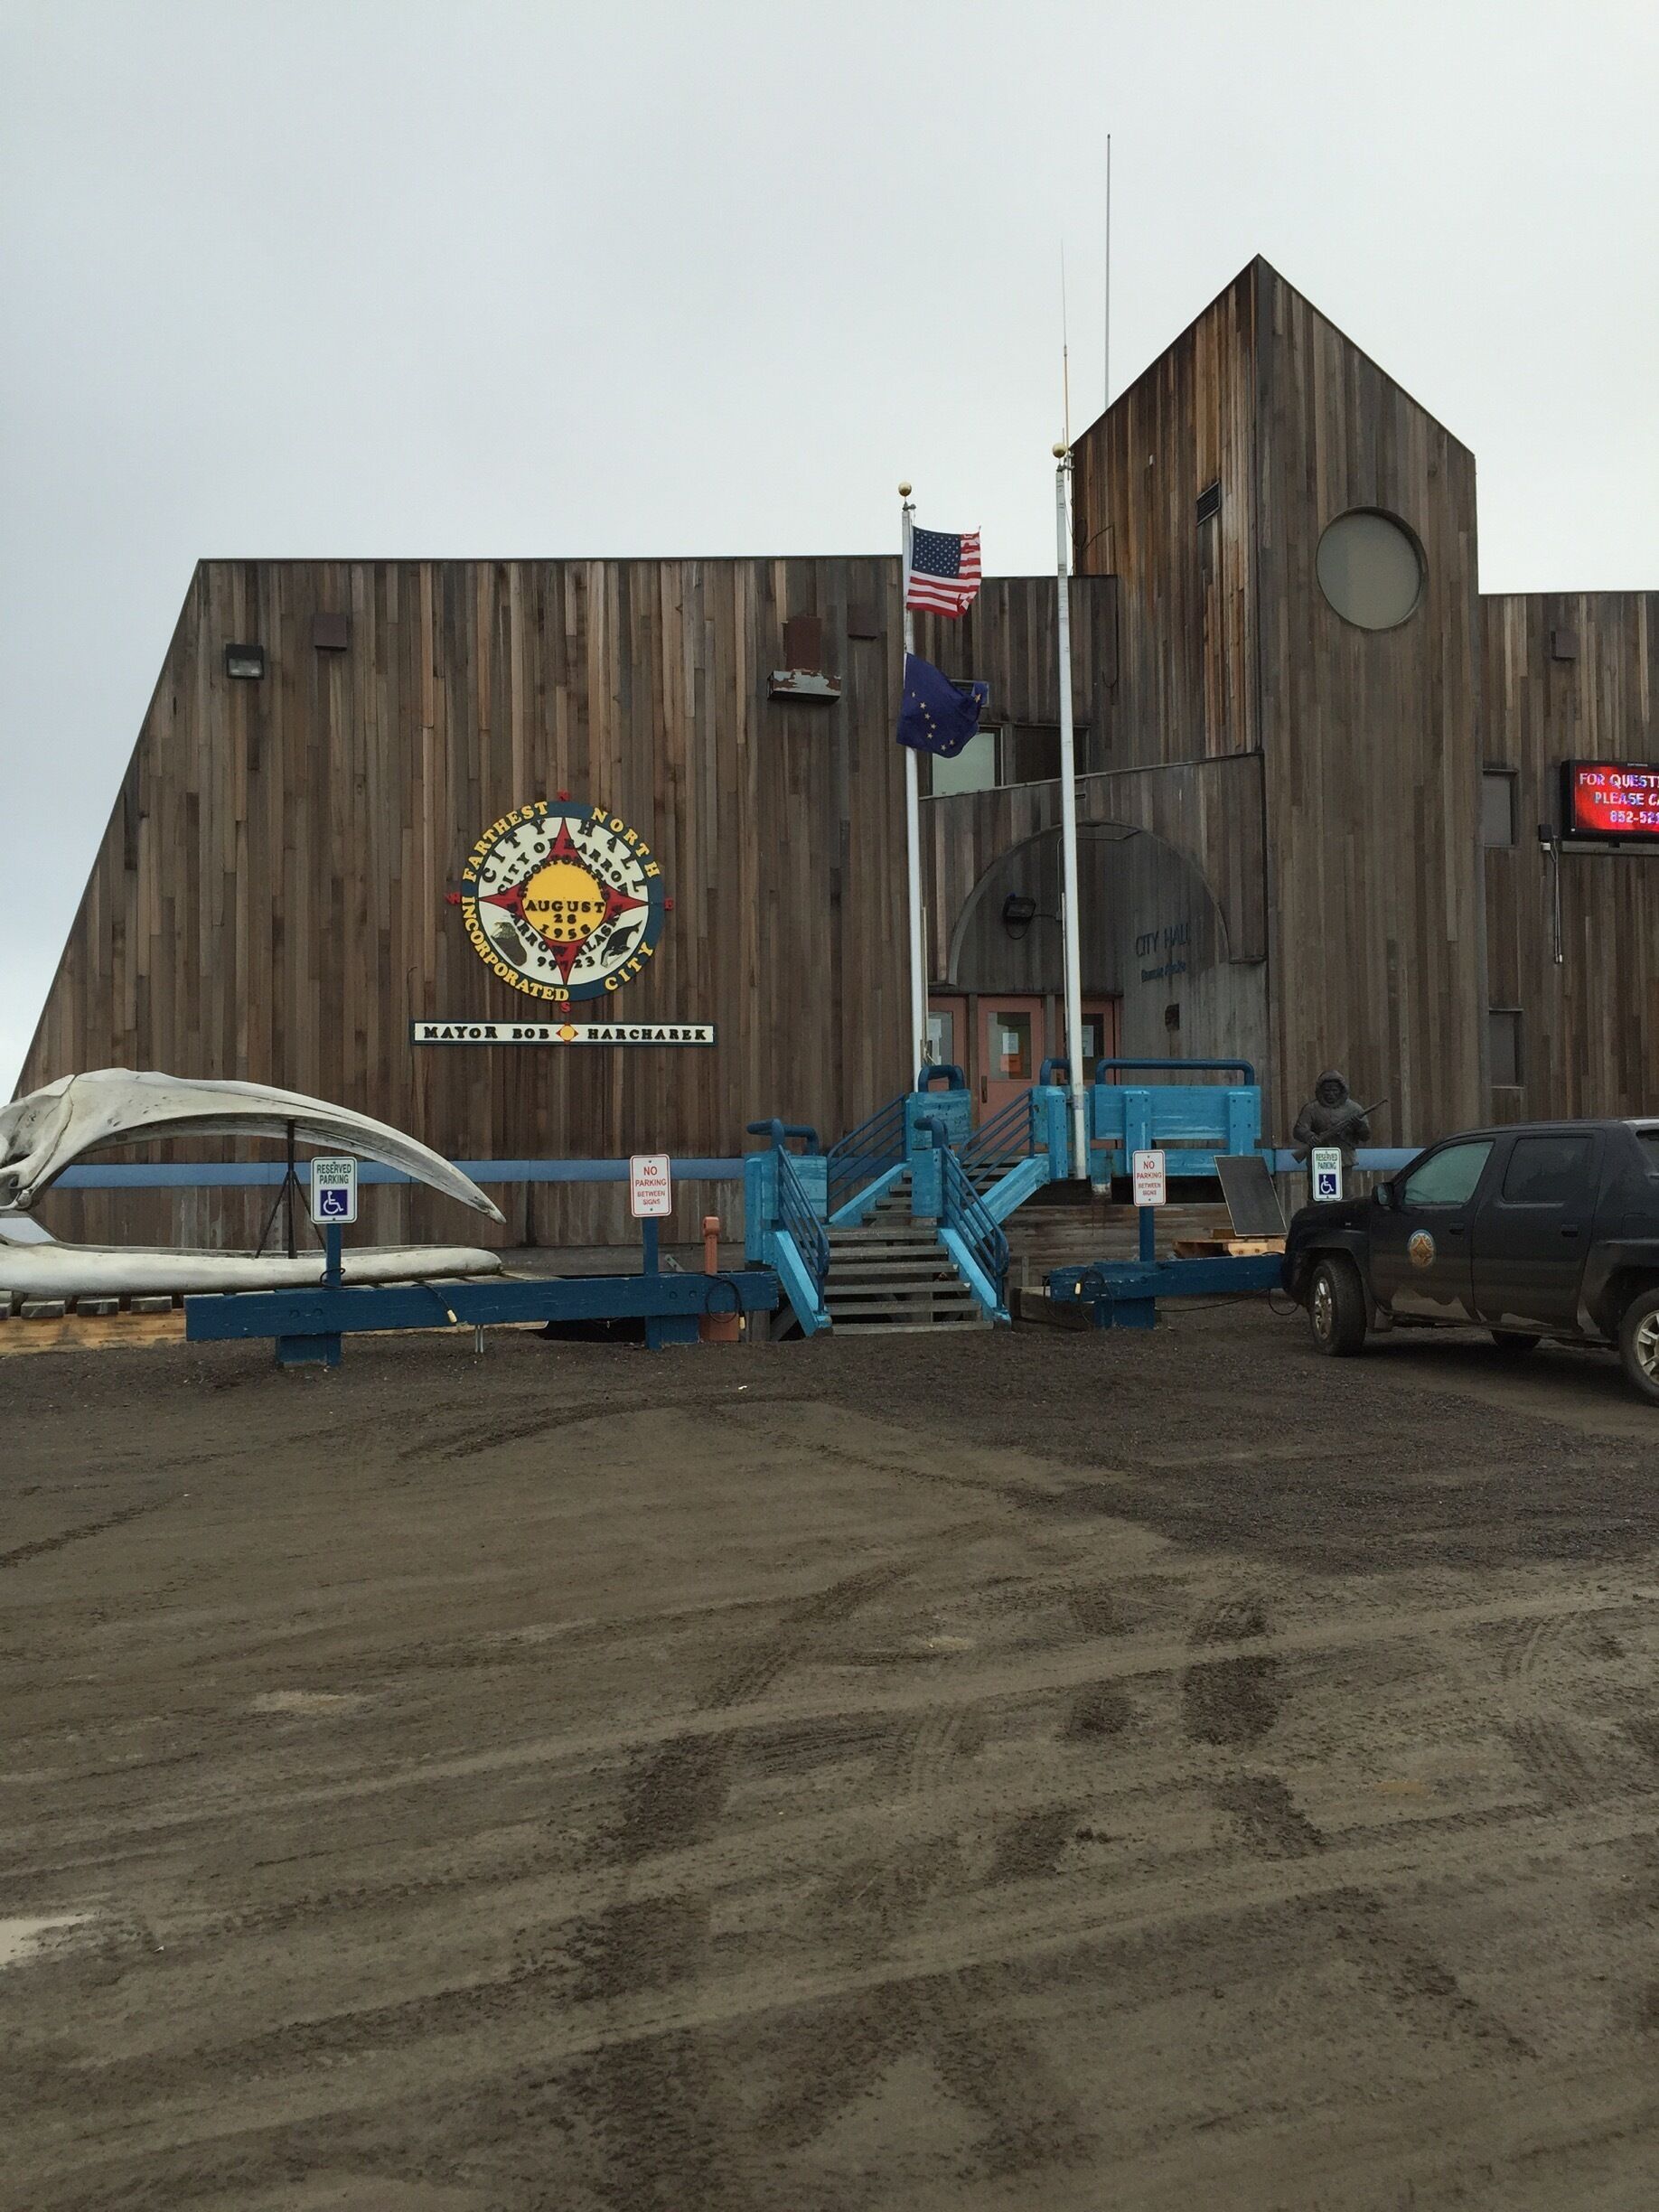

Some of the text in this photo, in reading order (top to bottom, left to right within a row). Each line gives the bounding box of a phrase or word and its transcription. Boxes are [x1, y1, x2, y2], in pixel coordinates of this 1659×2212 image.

[1579, 773, 1606, 785] FOR
[1594, 792, 1645, 805] PLEASE
[462, 801, 661, 882] FARTHEST NORTH
[482, 818, 646, 893] CITY HALL
[497, 852, 530, 895] CITY
[563, 838, 629, 896] BARROW
[525, 899, 605, 914] AUGUST
[553, 914, 576, 924] 28
[507, 902, 623, 957] BARROW ALASKA
[462, 895, 653, 1001] INCORPORATED CITY
[1136, 930, 1159, 958] CITY
[537, 956, 595, 971] 99723
[424, 1026, 707, 1040] MAYOR BOB HARCHAREK
[1316, 1153, 1337, 1162] RESERVED
[316, 1163, 352, 1174] RESERVED
[643, 1166, 658, 1176] NO
[1143, 1160, 1155, 1169] NO
[1318, 1161, 1337, 1170] PARKING
[319, 1174, 349, 1185] PARKING
[635, 1178, 667, 1186] PARKING
